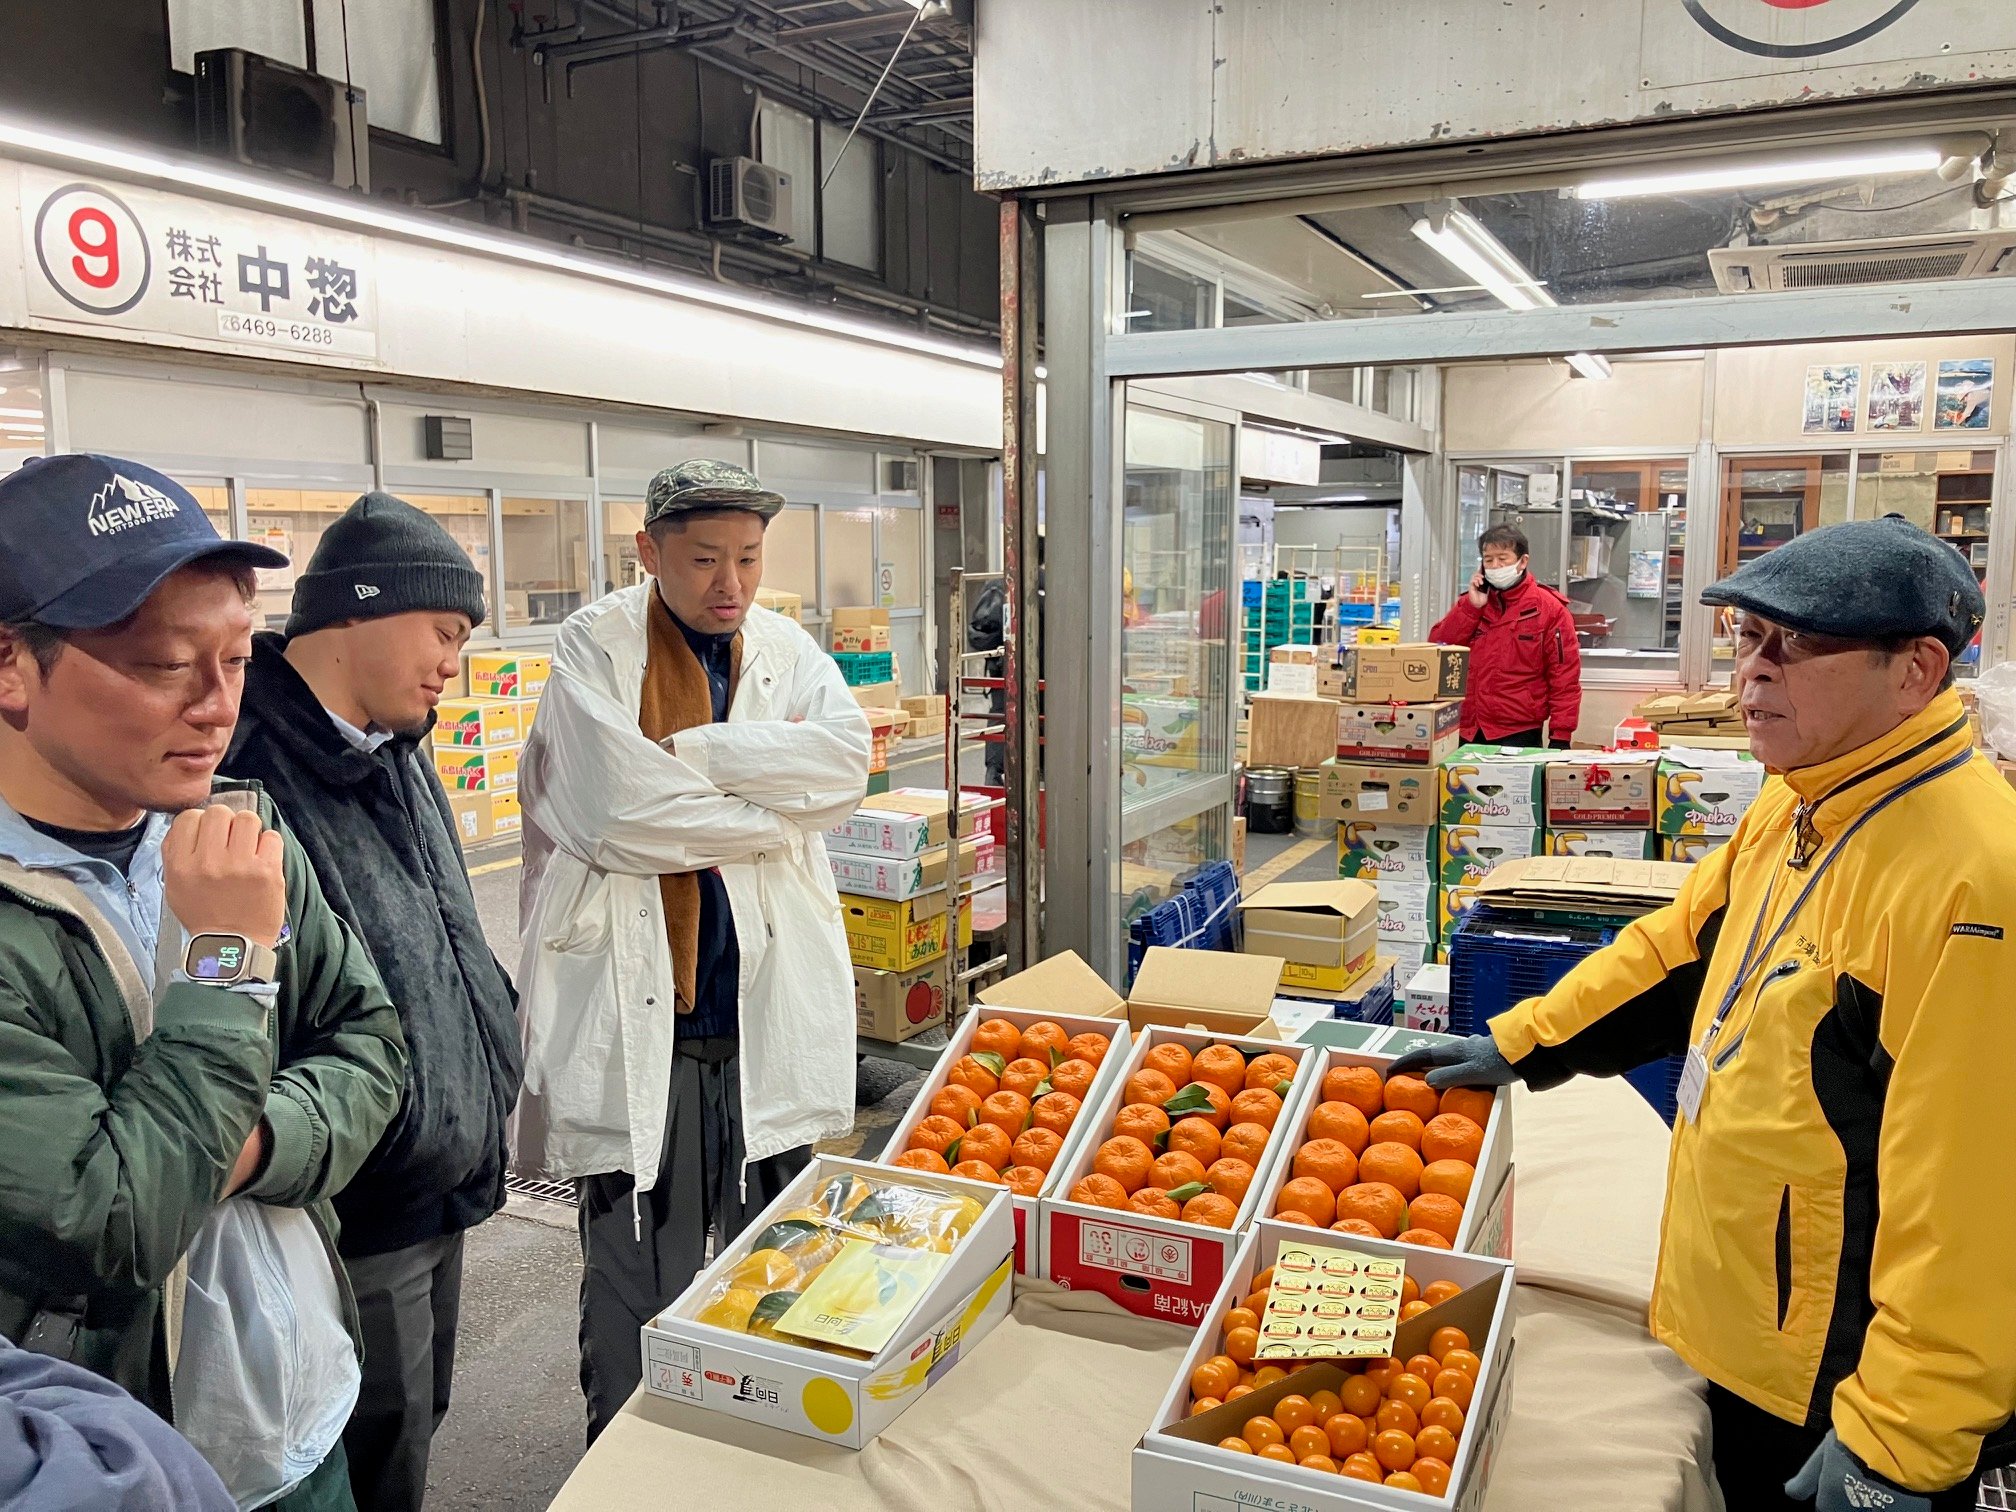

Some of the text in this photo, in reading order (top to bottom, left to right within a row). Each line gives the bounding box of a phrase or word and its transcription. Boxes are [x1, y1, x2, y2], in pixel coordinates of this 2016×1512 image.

[69, 207, 120, 289] 9
[166, 227, 222, 267] 株式
[168, 266, 225, 305] 会社
[88, 496, 180, 536] NEW ERA
[109, 511, 175, 535] OUTDOOR GEAR
[1408, 664, 1427, 674] Dole
[1685, 806, 1737, 828] proba
[1360, 854, 1406, 873] proba
[660, 1368, 673, 1383] 12
[681, 1371, 693, 1387] 秀
